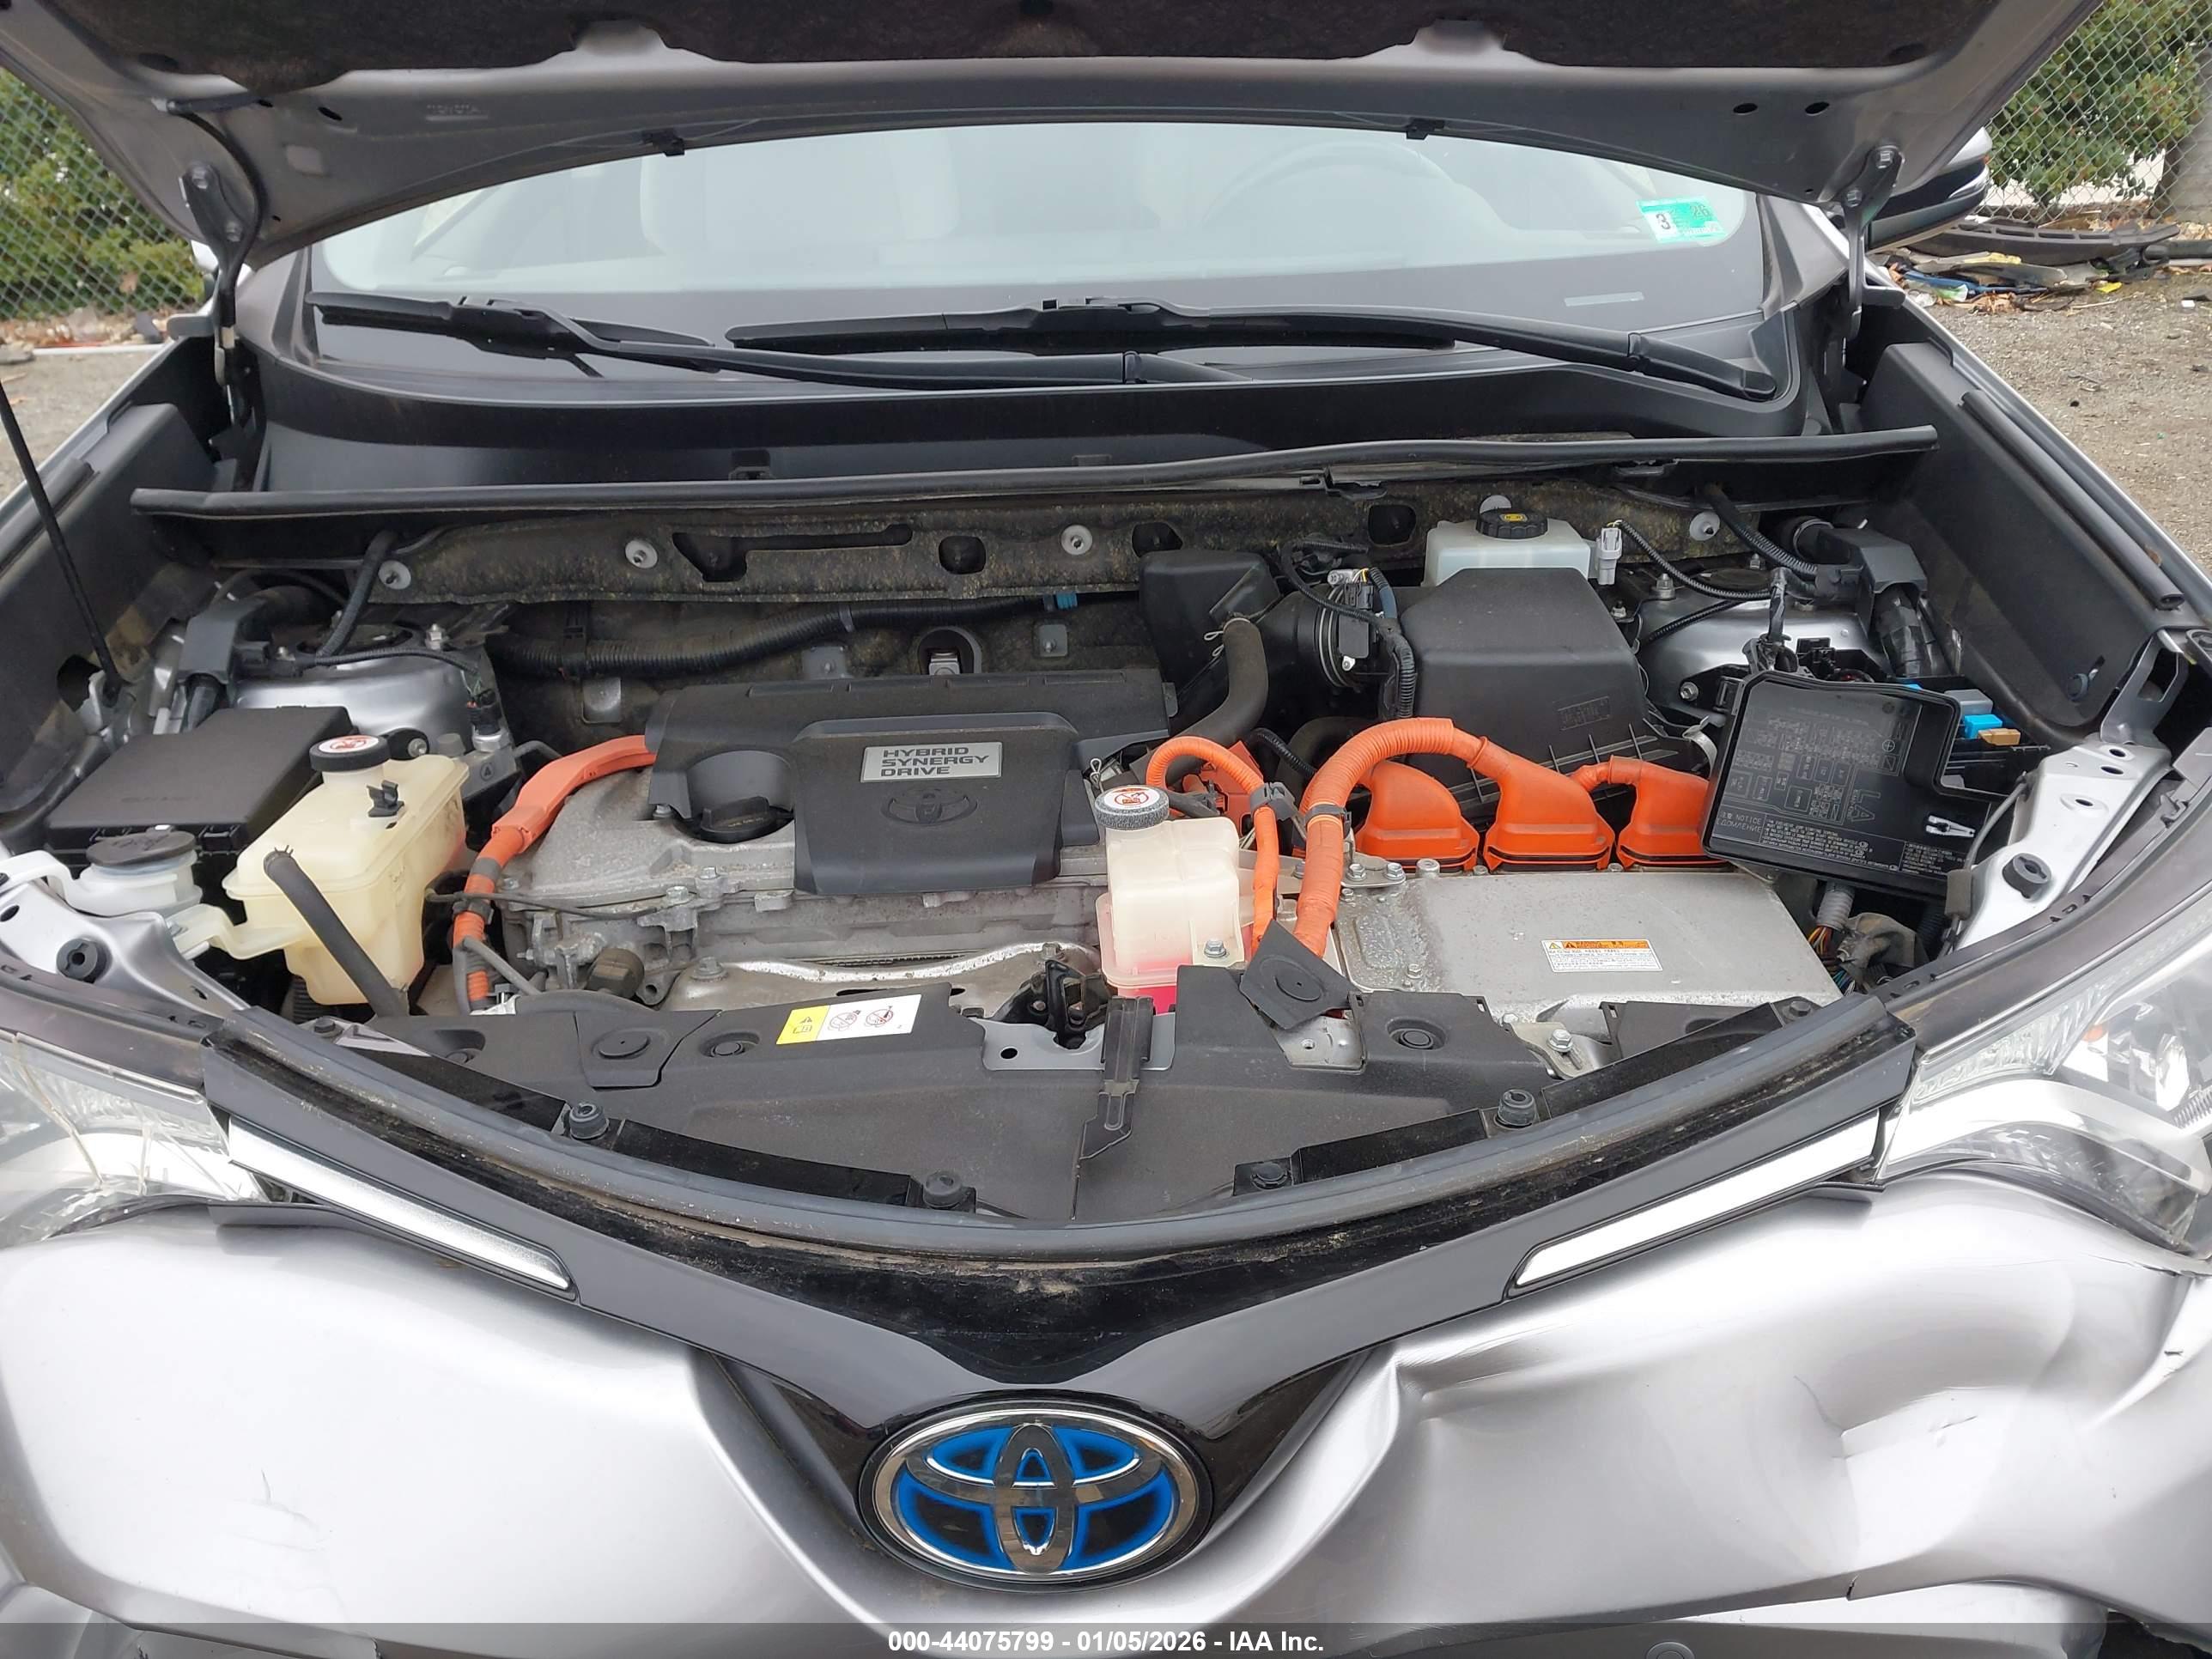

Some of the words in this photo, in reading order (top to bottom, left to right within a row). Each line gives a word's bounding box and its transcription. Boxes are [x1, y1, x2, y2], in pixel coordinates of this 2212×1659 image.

[1656, 213, 1671, 229] 3
[883, 747, 969, 758] HYBRID
[882, 756, 989, 768] SYNERGY
[881, 766, 951, 777] DRIVE
[1735, 813, 1762, 825] NOTICE
